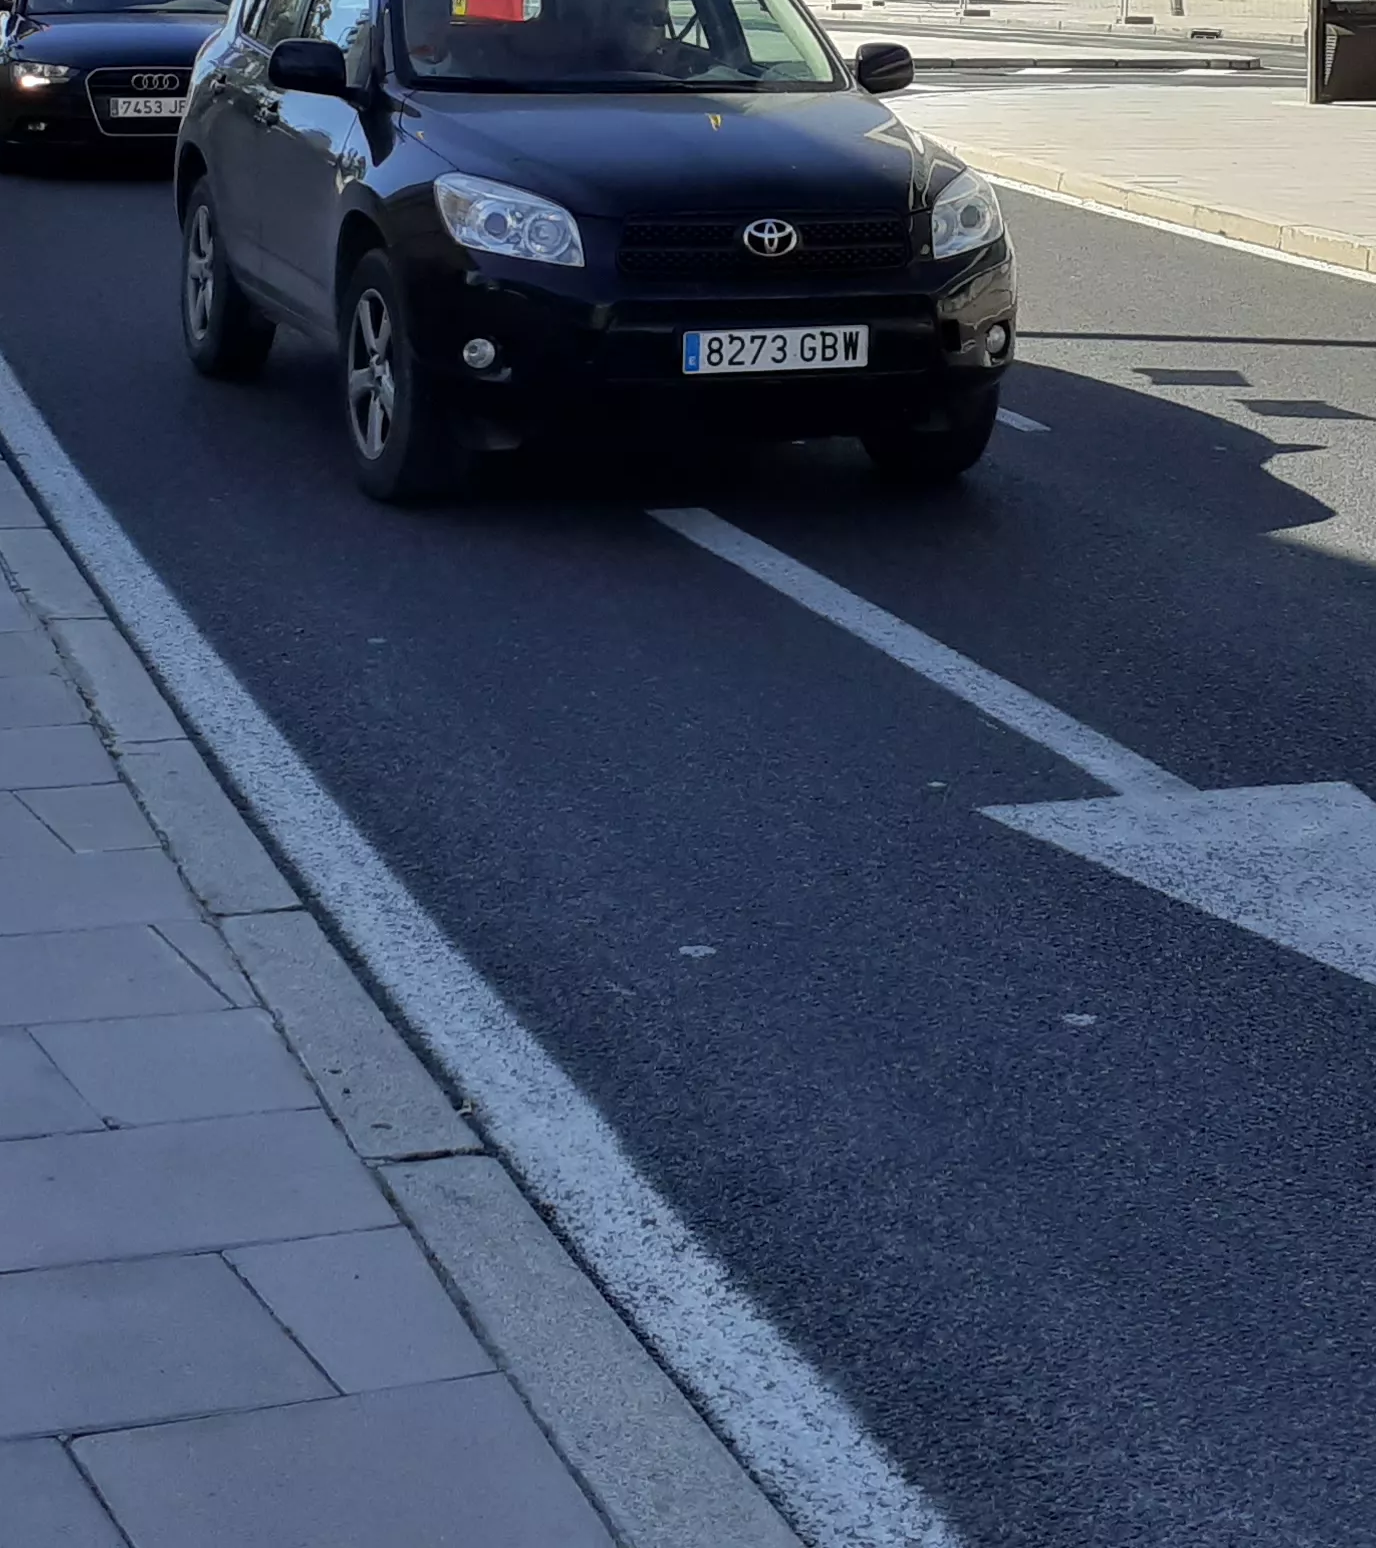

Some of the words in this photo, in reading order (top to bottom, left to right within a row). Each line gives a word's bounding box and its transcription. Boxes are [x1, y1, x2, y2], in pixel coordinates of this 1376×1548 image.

[122, 100, 163, 114] 7453
[706, 334, 788, 367] 8273
[799, 330, 861, 362] GBW
